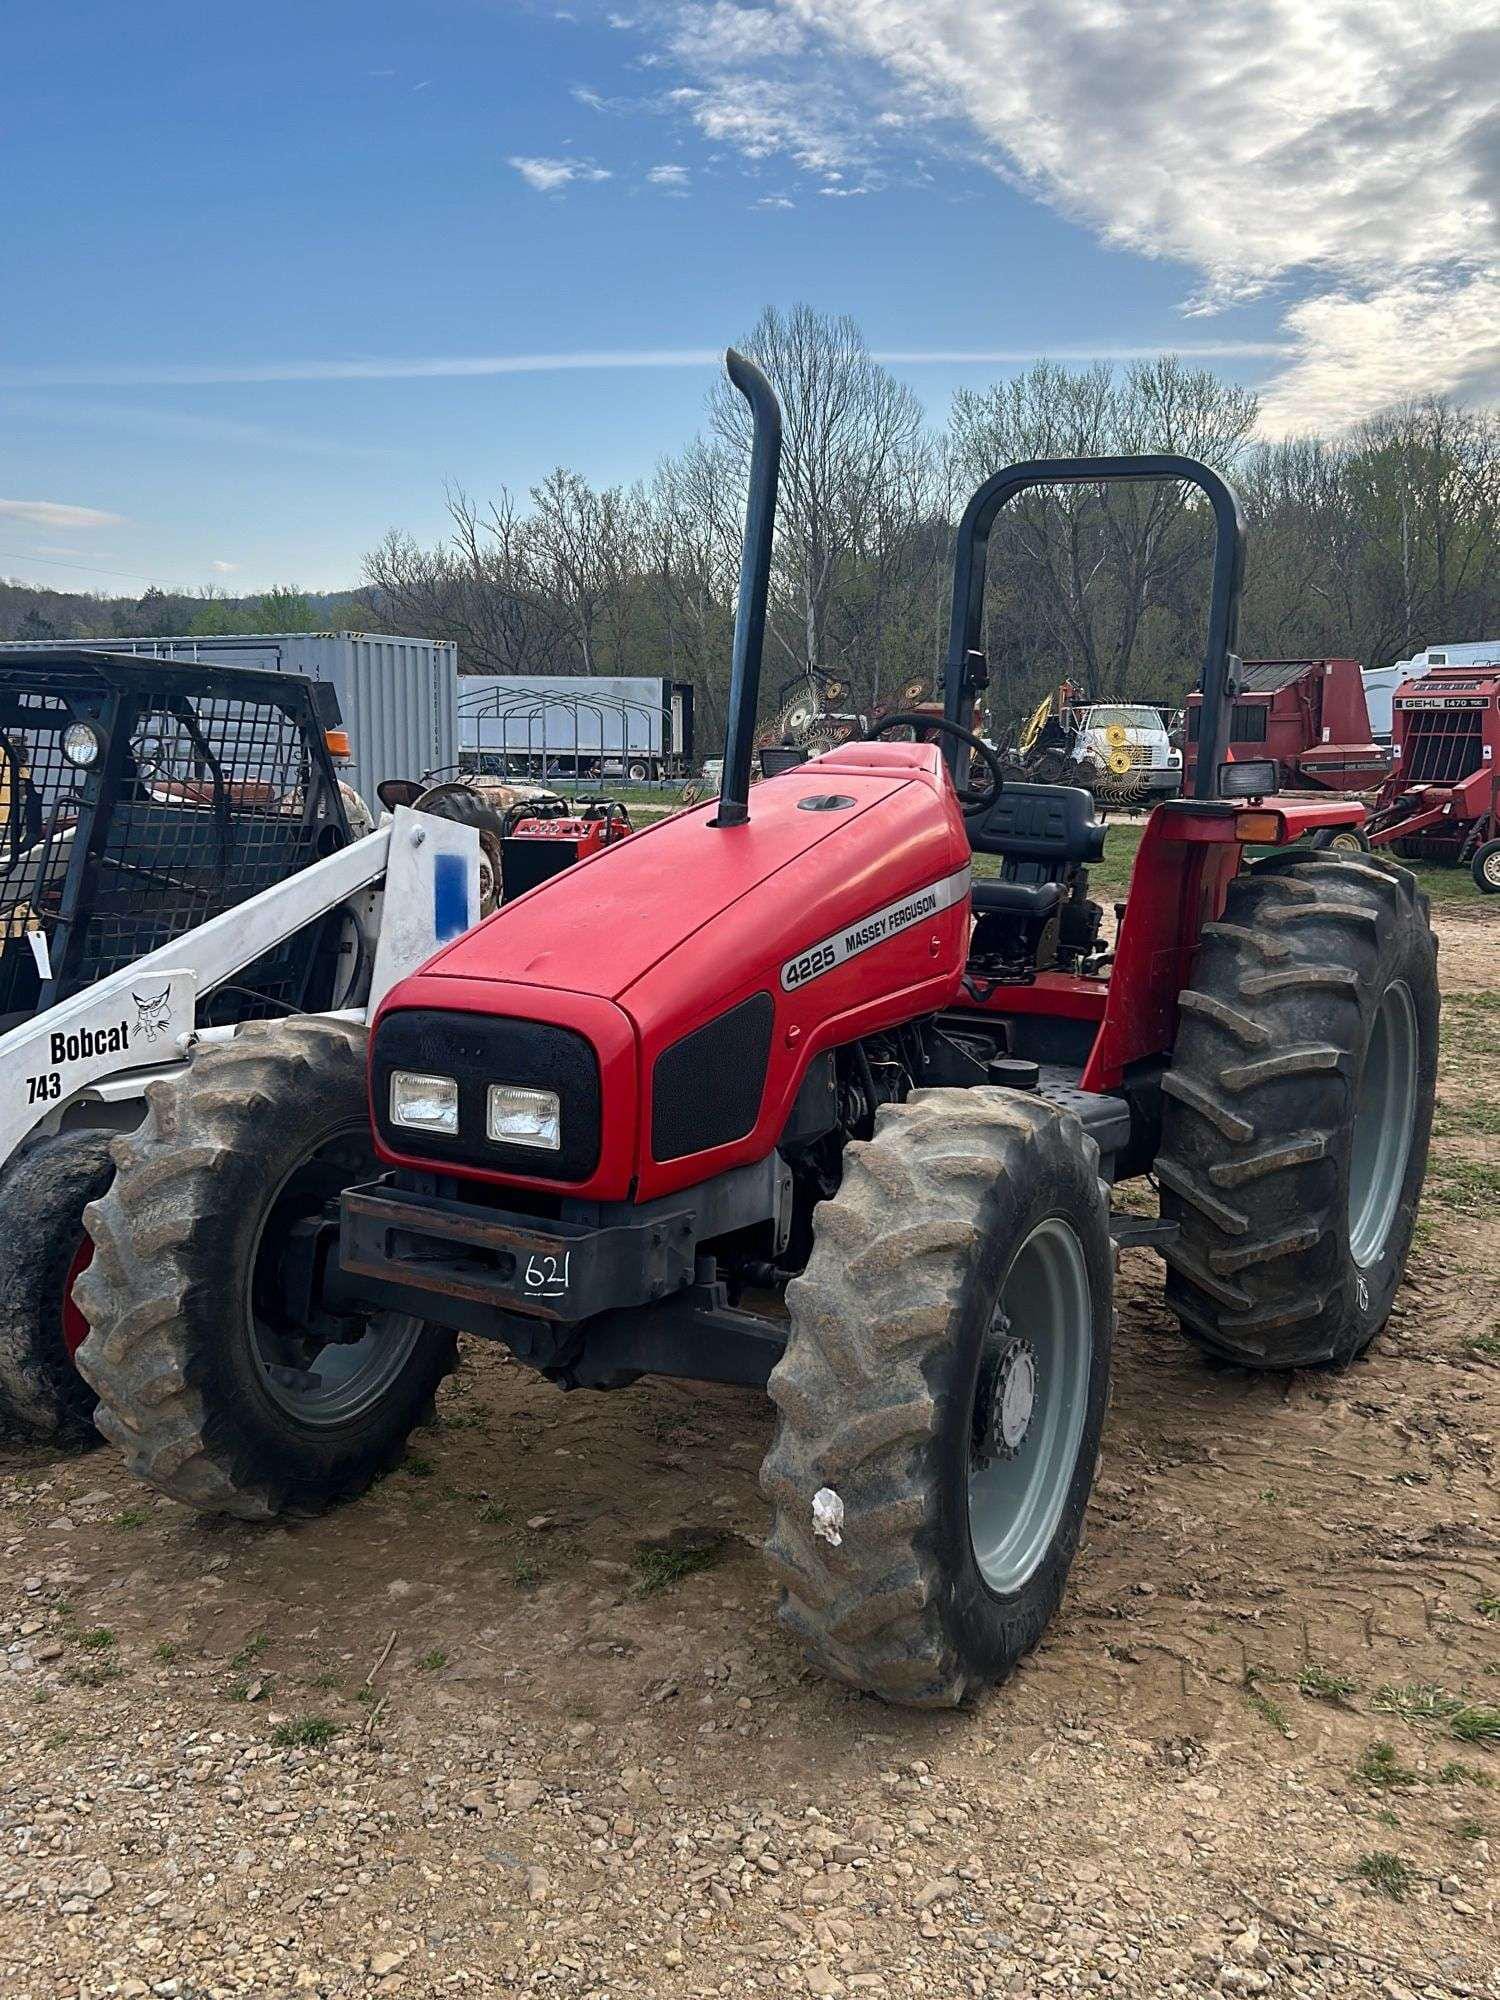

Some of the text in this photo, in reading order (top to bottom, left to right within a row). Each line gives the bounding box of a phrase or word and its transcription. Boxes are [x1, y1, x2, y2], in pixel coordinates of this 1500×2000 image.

[1405, 700, 1441, 708] GEHL
[786, 893, 937, 985] 4225 MASSEY FERGUSON
[50, 1020, 129, 1065] Bobcat
[26, 1072, 62, 1105] 743
[525, 1251, 570, 1288] 621
